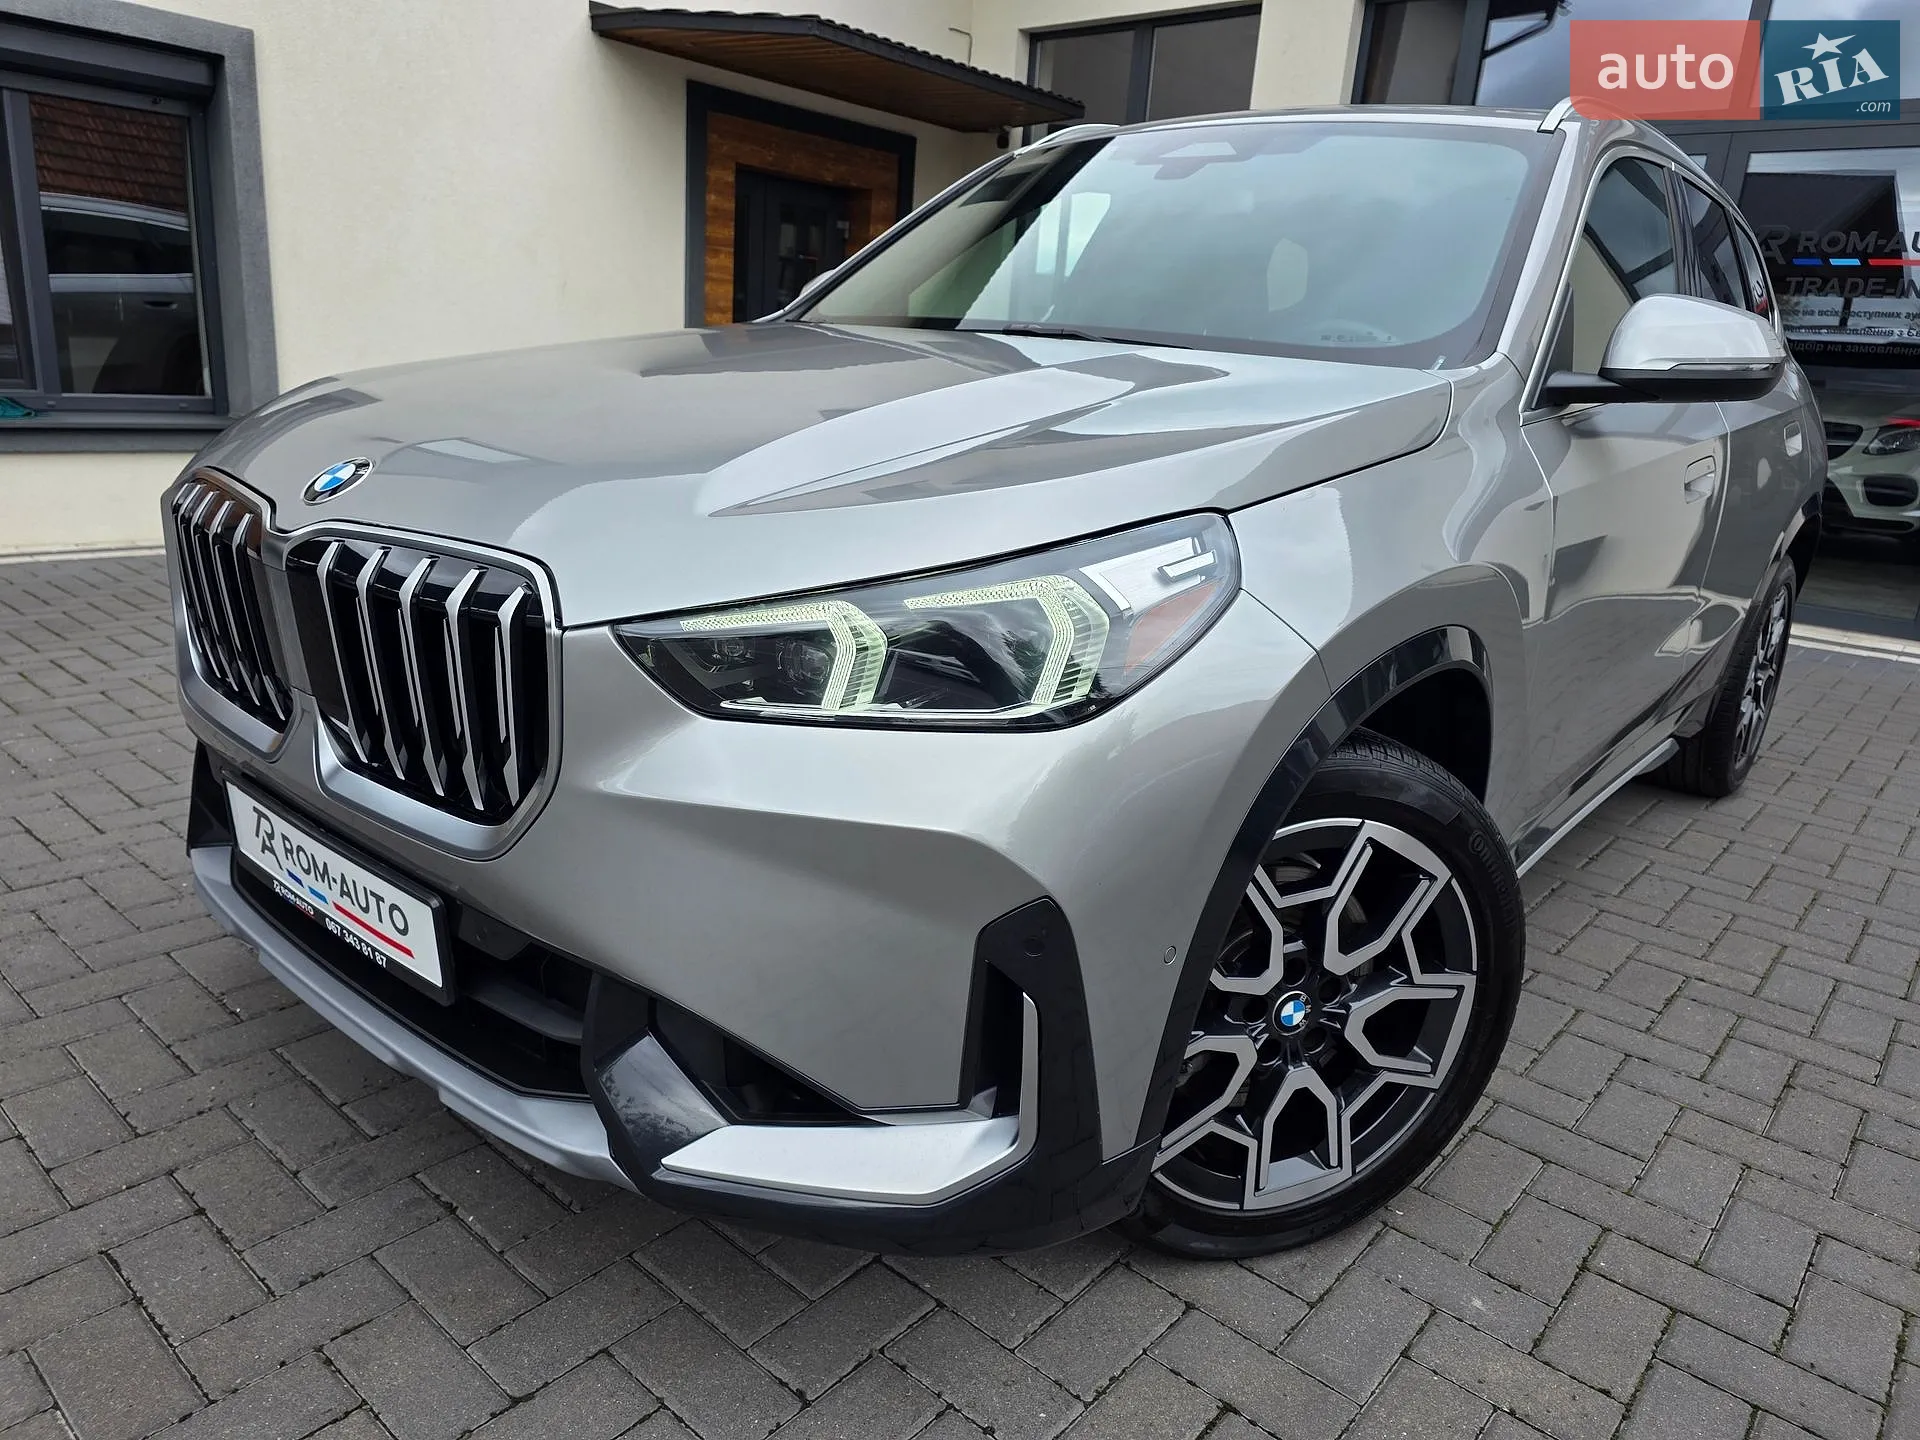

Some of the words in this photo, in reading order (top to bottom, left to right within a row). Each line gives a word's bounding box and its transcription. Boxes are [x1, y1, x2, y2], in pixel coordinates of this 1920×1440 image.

[1786, 277, 1920, 299] TRADE-IN
[1843, 309, 1902, 320] оступних
[281, 833, 409, 937] ROM-AUTO
